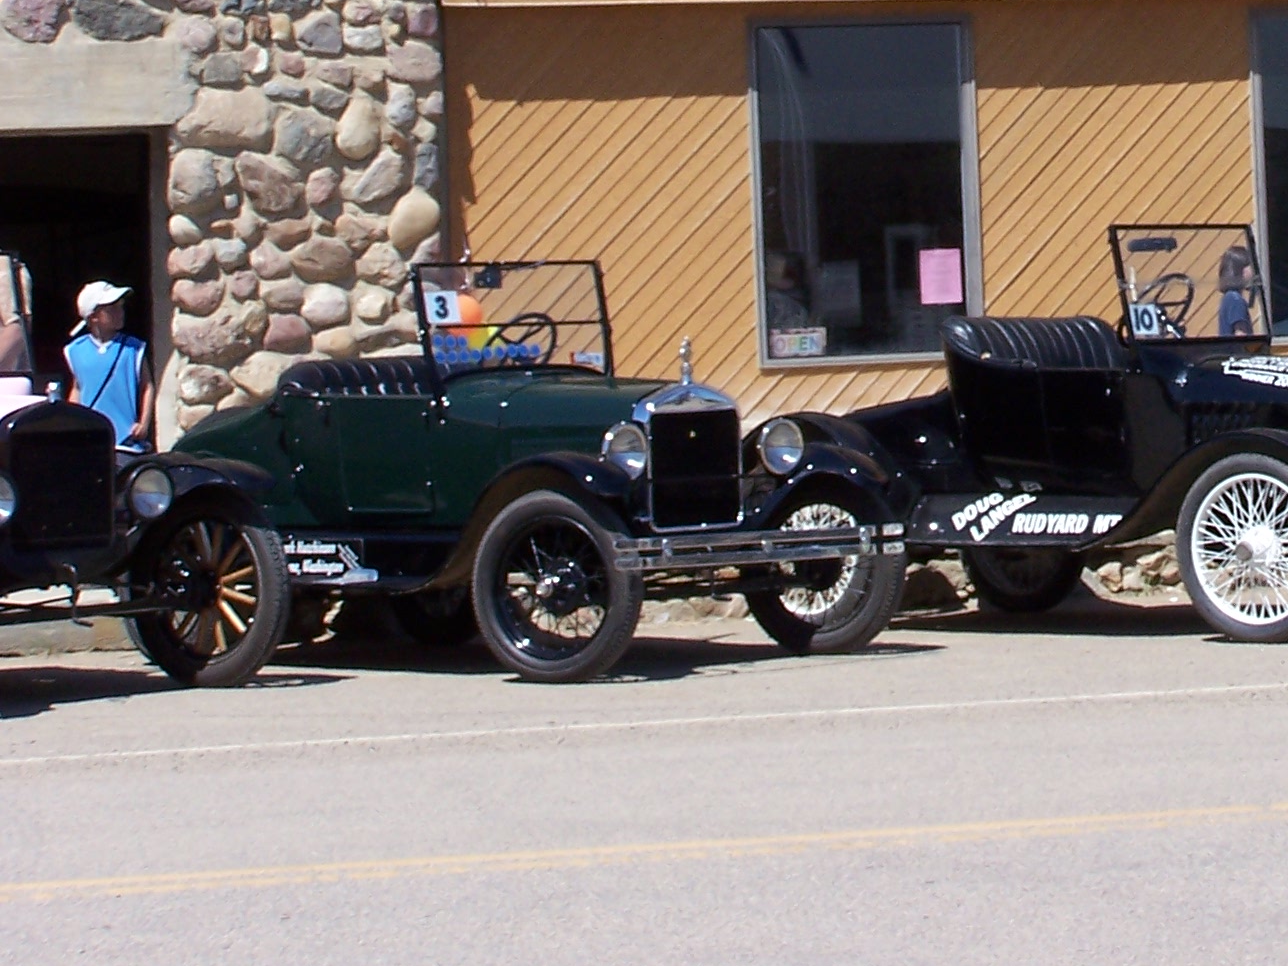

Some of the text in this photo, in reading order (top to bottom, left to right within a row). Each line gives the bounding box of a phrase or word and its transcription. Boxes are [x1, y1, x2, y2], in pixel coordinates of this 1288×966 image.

[434, 295, 449, 320] 3
[1133, 307, 1153, 331] 10
[951, 492, 1004, 531] DOUG
[969, 493, 1037, 542] LANGEL
[1011, 512, 1123, 534] RUDYARD MT
